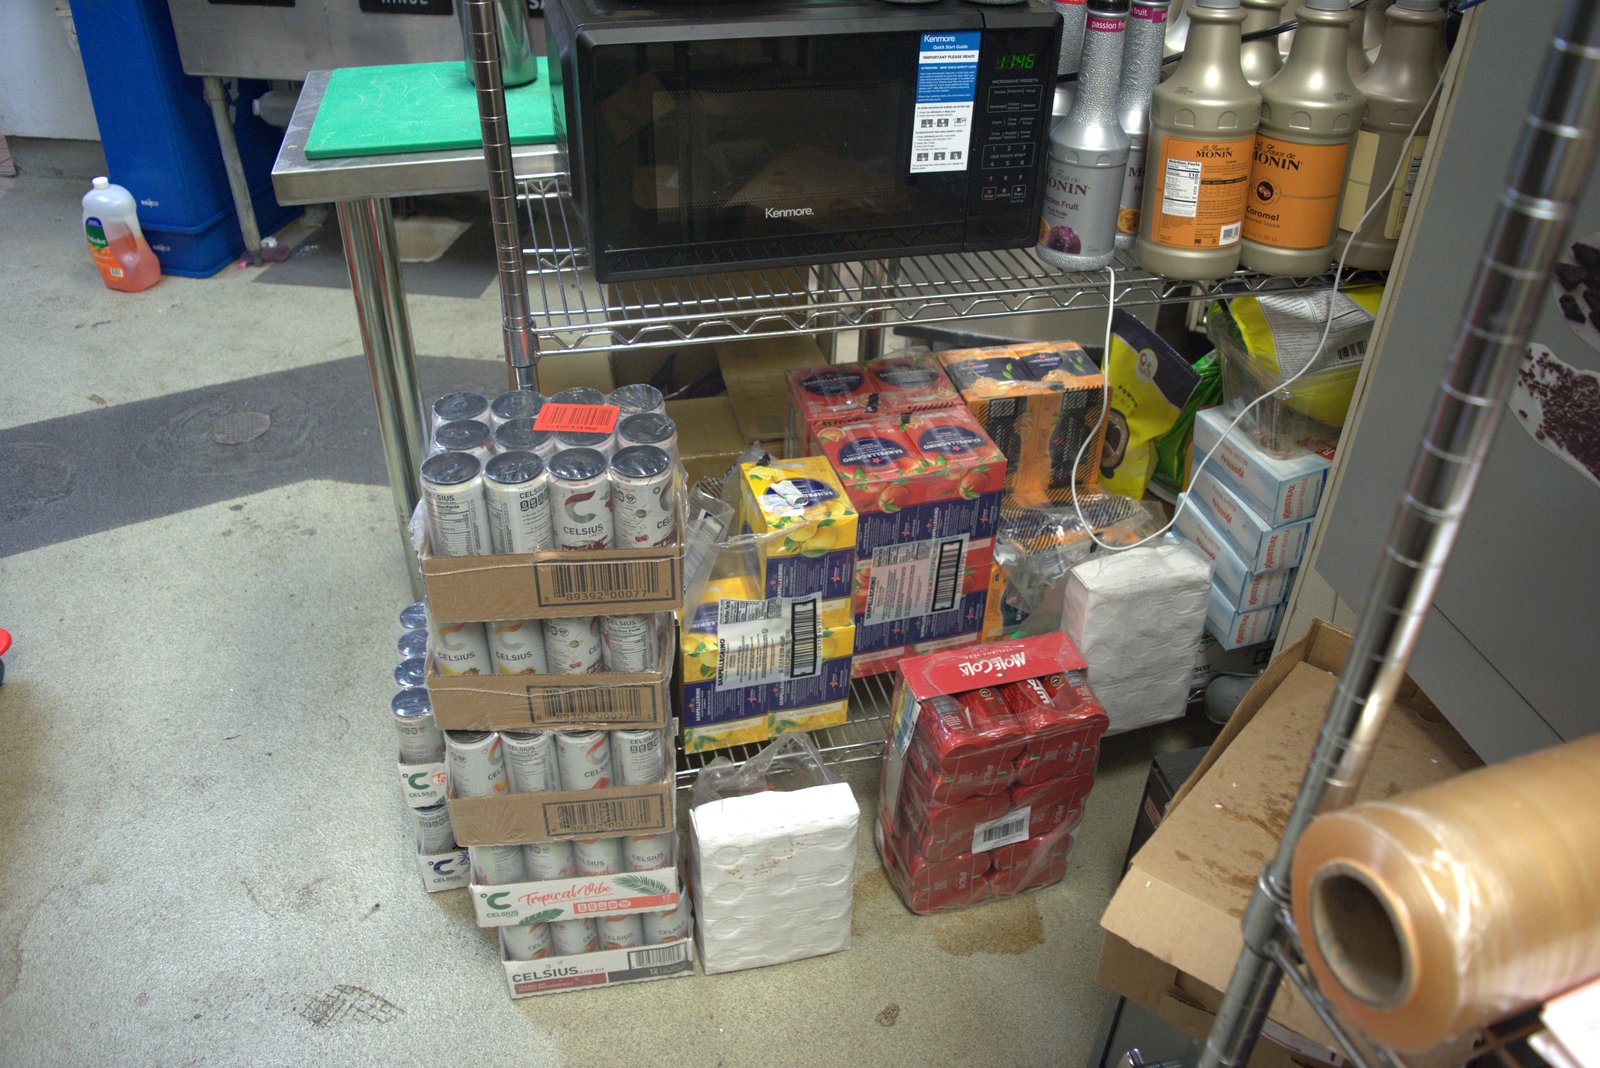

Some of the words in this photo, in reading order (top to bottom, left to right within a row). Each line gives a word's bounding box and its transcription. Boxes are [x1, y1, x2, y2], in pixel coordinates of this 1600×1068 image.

[1091, 21, 1117, 30] passion
[924, 34, 956, 43] Kenmore
[1196, 150, 1233, 158] MONIN
[1047, 177, 1089, 196] ONIN
[1061, 200, 1079, 211] Fruit
[765, 207, 814, 219] Kenmore
[1246, 205, 1280, 221] Caramel
[923, 437, 982, 450] SANPELLEGRINO
[842, 449, 904, 464] SANPELLEGRINO
[1282, 483, 1296, 520] KRUSTEAZ
[563, 523, 604, 536] CELSIUS
[1264, 534, 1278, 570] KRUSTEAZ
[566, 592, 603, 601] 89392
[610, 590, 648, 599] 00077
[1248, 574, 1262, 606] KRUSTEAZ
[865, 576, 876, 620] SANPELLEGRINO
[1235, 613, 1249, 644] KRUSTEAZ
[438, 651, 476, 662] CELSIUS
[495, 651, 534, 661] CELSIUS
[717, 638, 726, 686] SANPELLEGRINO
[507, 744, 536, 752] CELSIUS
[408, 790, 437, 798] CELSIUS
[631, 852, 665, 862] CELSIUS
[433, 875, 462, 884] CELSIUS
[518, 885, 577, 907] Tropical
[577, 881, 613, 896] Vibe
[486, 910, 520, 919] CELSIUS
[603, 932, 633, 941] CELSIUS
[512, 966, 579, 983] CELSIUS
